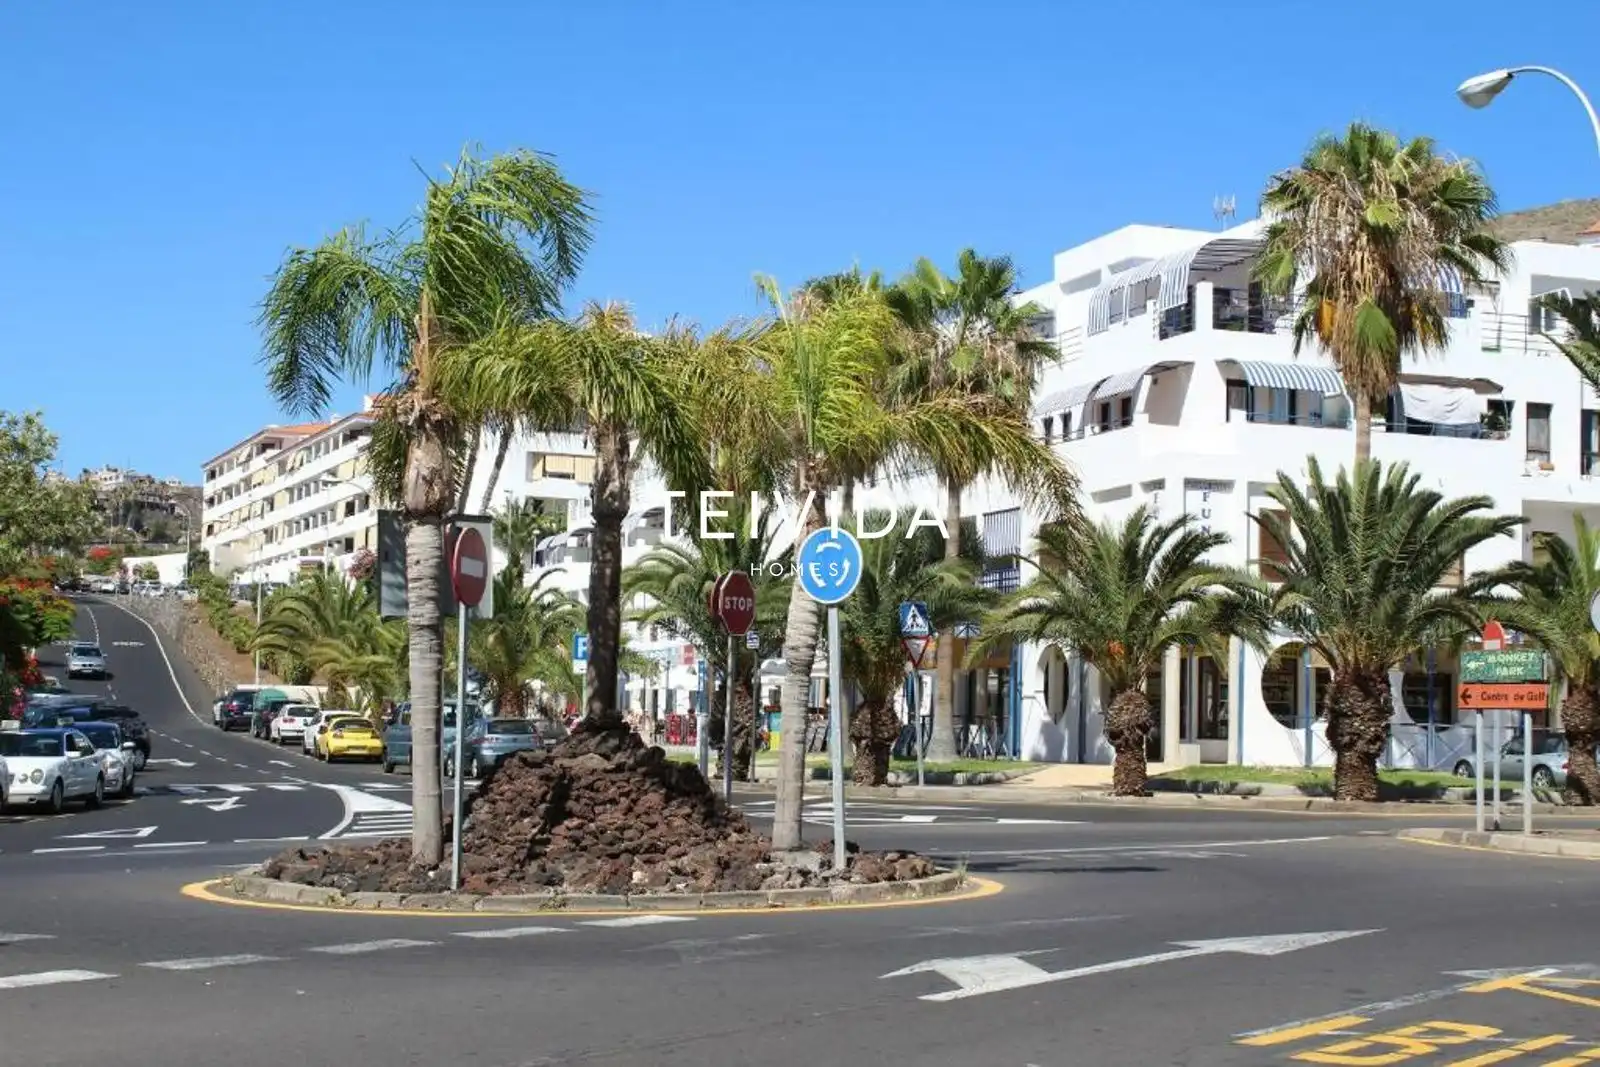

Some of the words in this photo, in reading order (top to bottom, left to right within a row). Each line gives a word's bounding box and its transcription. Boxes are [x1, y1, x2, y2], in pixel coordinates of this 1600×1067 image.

[724, 595, 753, 612] STOP
[1487, 651, 1536, 664] MONKEY
[1496, 666, 1525, 676] PARK
[1513, 691, 1525, 701] de
[1527, 691, 1546, 701] Golf
